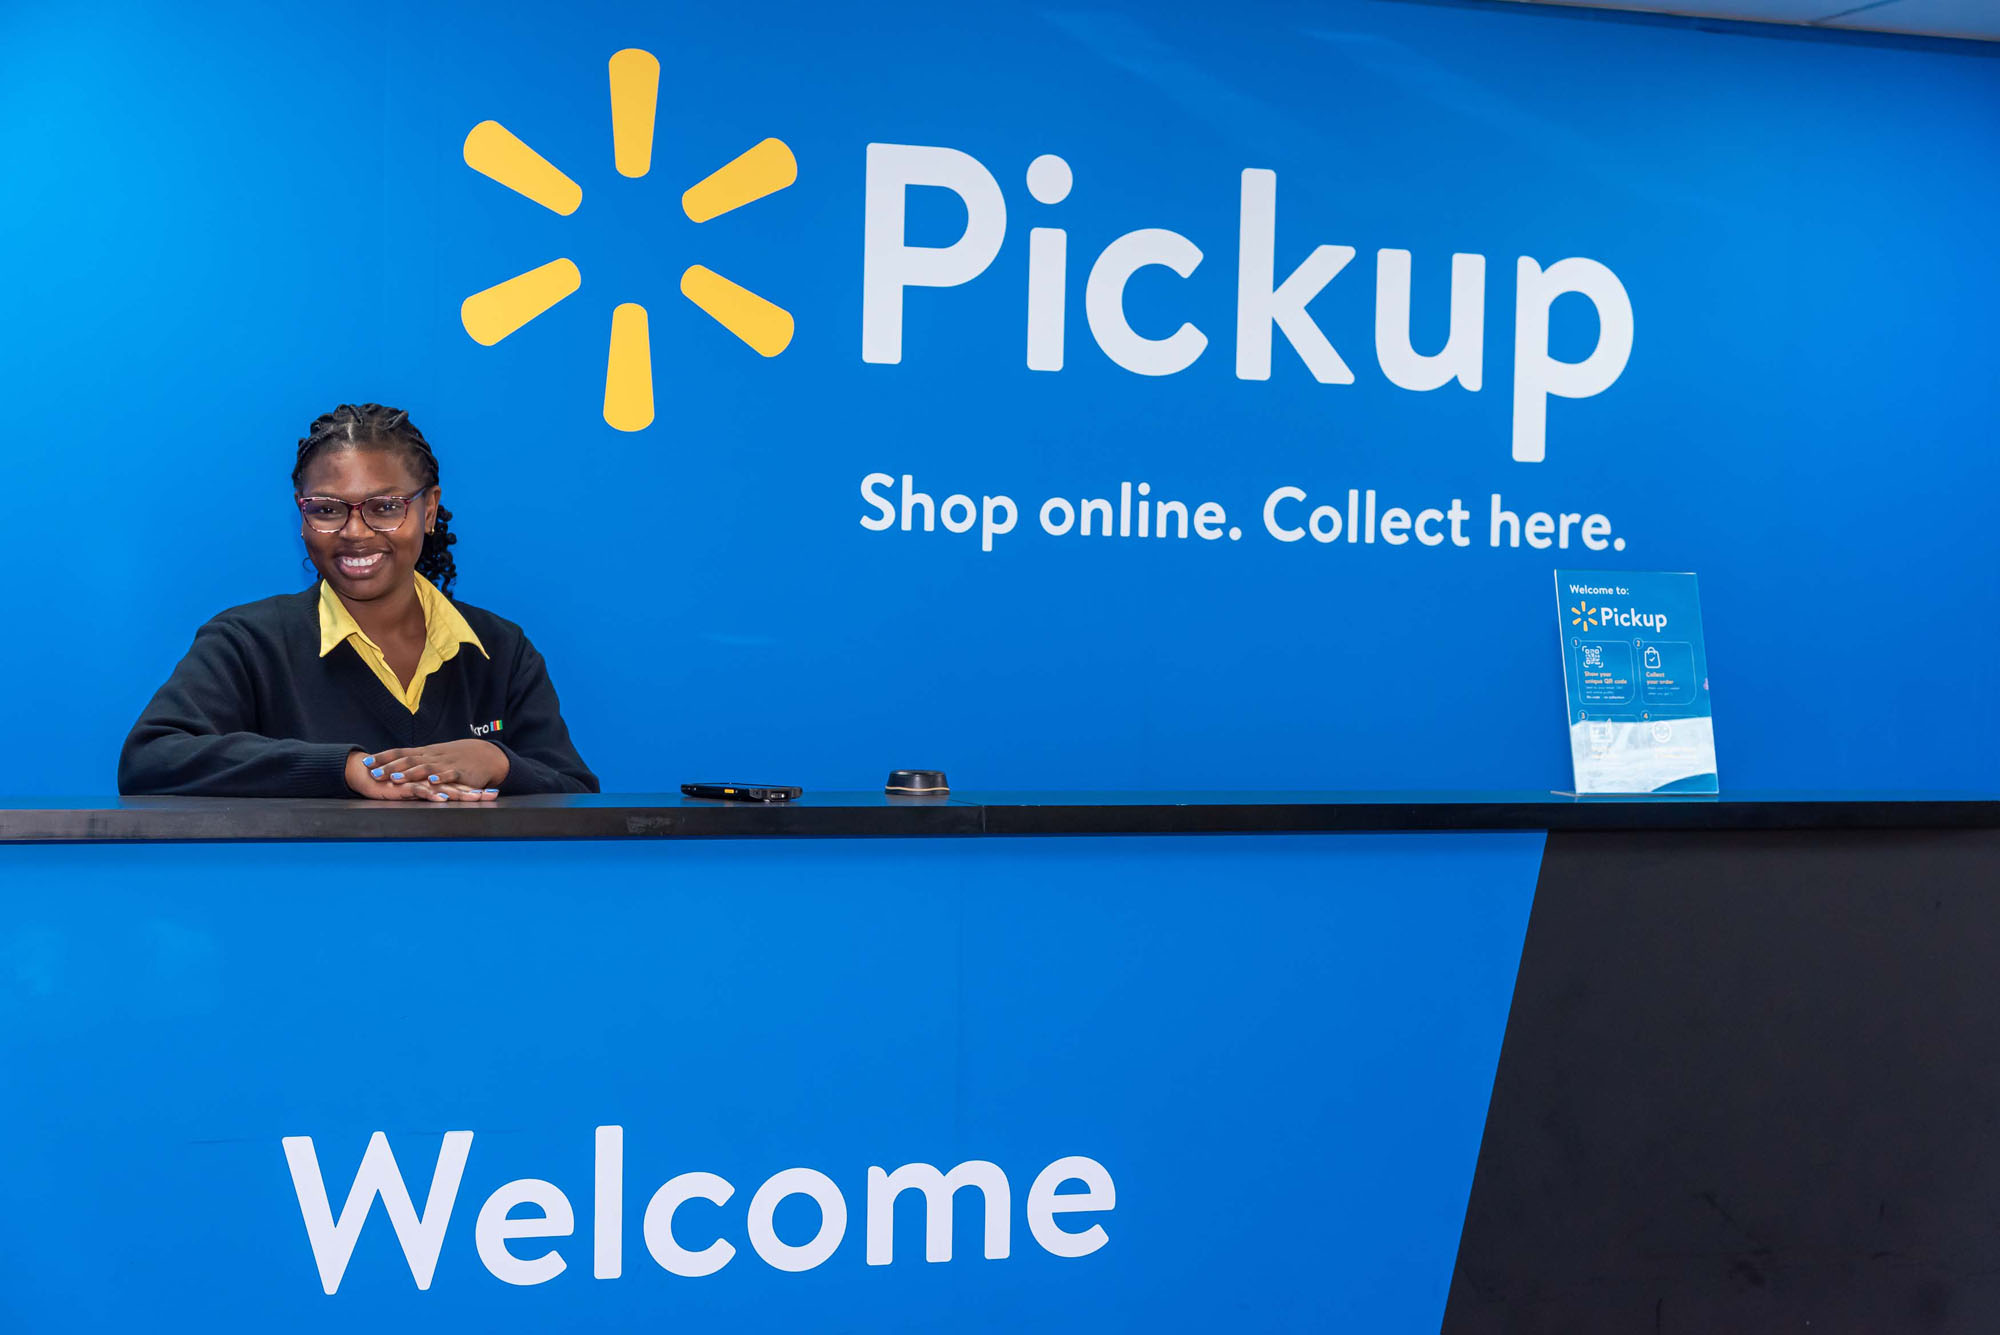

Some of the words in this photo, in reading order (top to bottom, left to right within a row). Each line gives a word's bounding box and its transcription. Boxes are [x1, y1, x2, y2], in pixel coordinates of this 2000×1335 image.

[862, 143, 1633, 462] Pickup
[859, 473, 1018, 552] Shop
[1039, 482, 1242, 541] online.
[1263, 486, 1470, 547] Collect
[1490, 494, 1626, 551] here.
[1569, 584, 1613, 595] Welcome
[1616, 585, 1629, 596] to:
[1600, 607, 1668, 632] Pickup
[469, 723, 490, 736] kro
[281, 1125, 1116, 1296] Welcome
